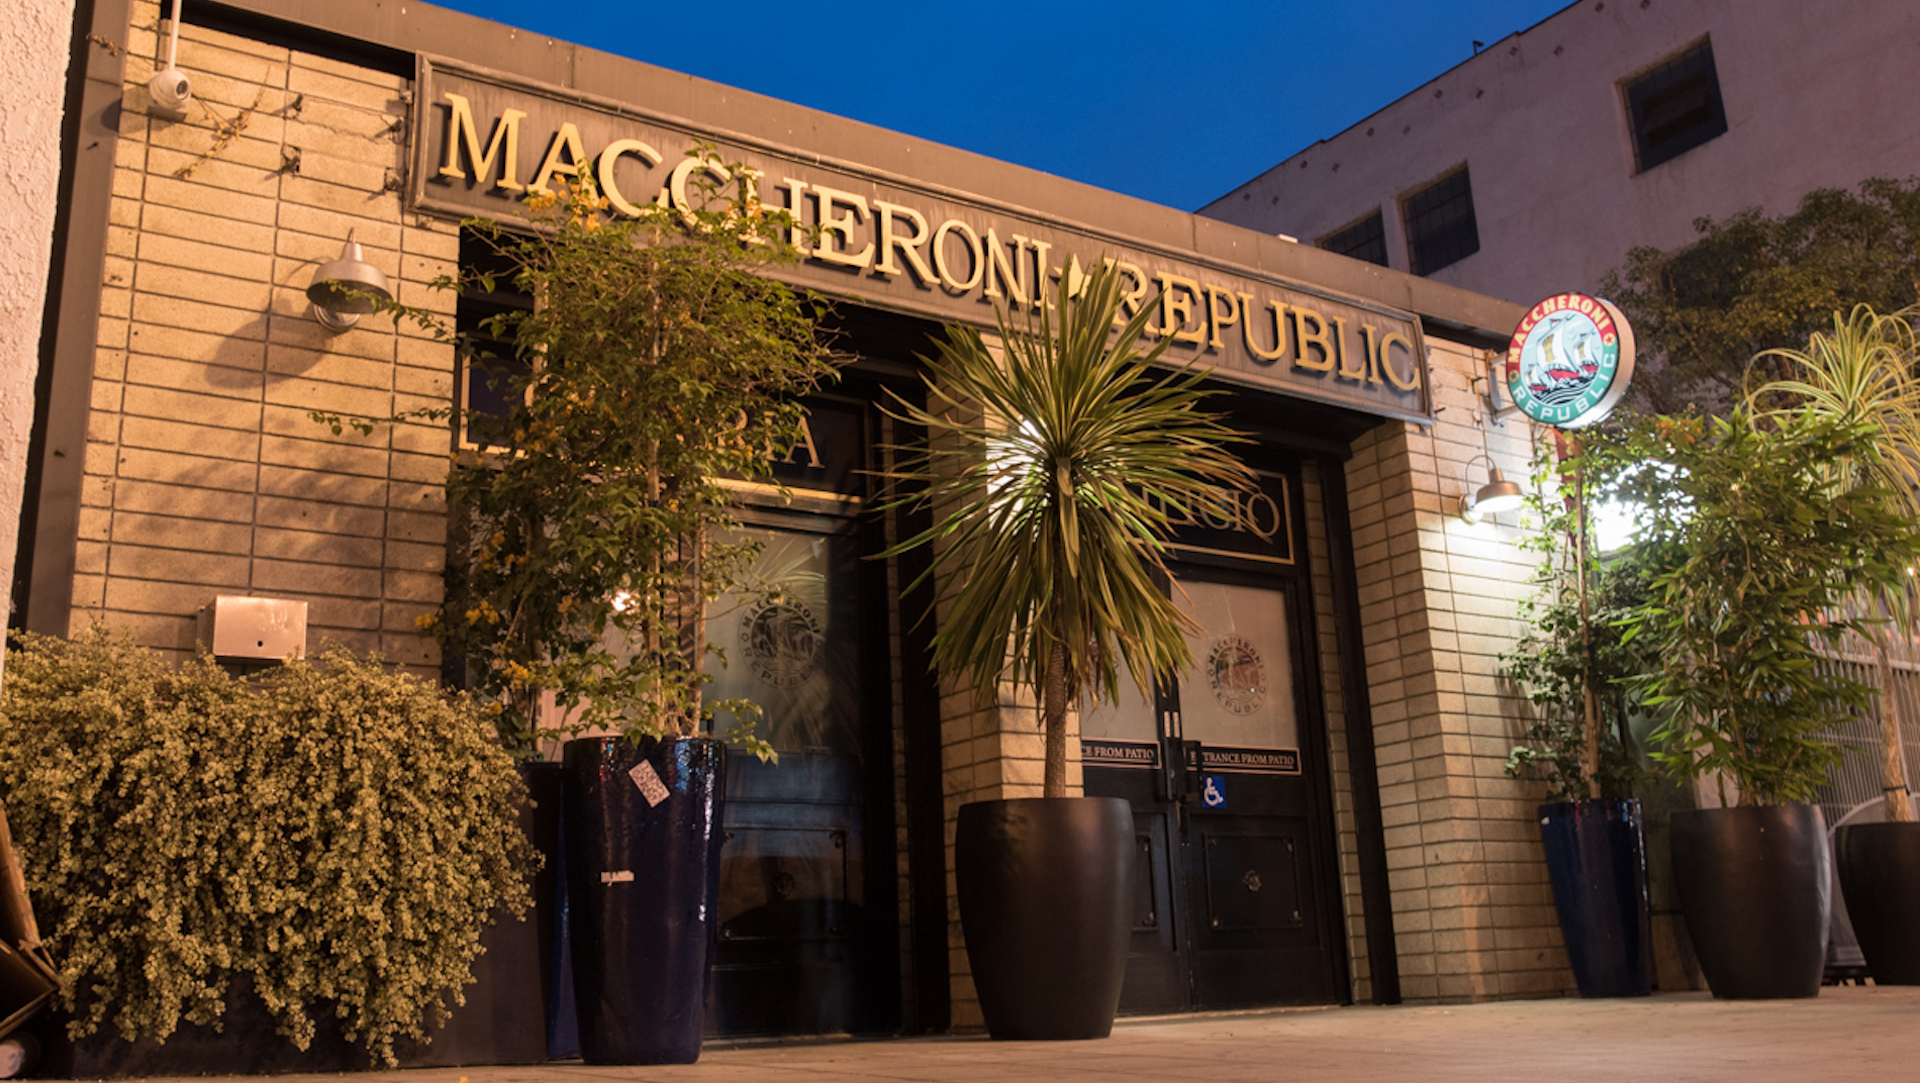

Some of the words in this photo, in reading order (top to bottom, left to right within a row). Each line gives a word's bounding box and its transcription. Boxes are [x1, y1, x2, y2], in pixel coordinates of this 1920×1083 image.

[439, 92, 1055, 311] MACCHERONI
[1103, 256, 1421, 392] REPUBLIC
[1508, 294, 1611, 363] MACCHERONI
[1513, 353, 1615, 420] REPUBLIC
[743, 597, 821, 634] MACCERONI
[1093, 747, 1124, 759] FROM
[1124, 749, 1154, 760] PATIO
[1190, 750, 1240, 763] ETRANCE
[1241, 753, 1268, 765] FROM
[1268, 754, 1295, 766] PATIO
